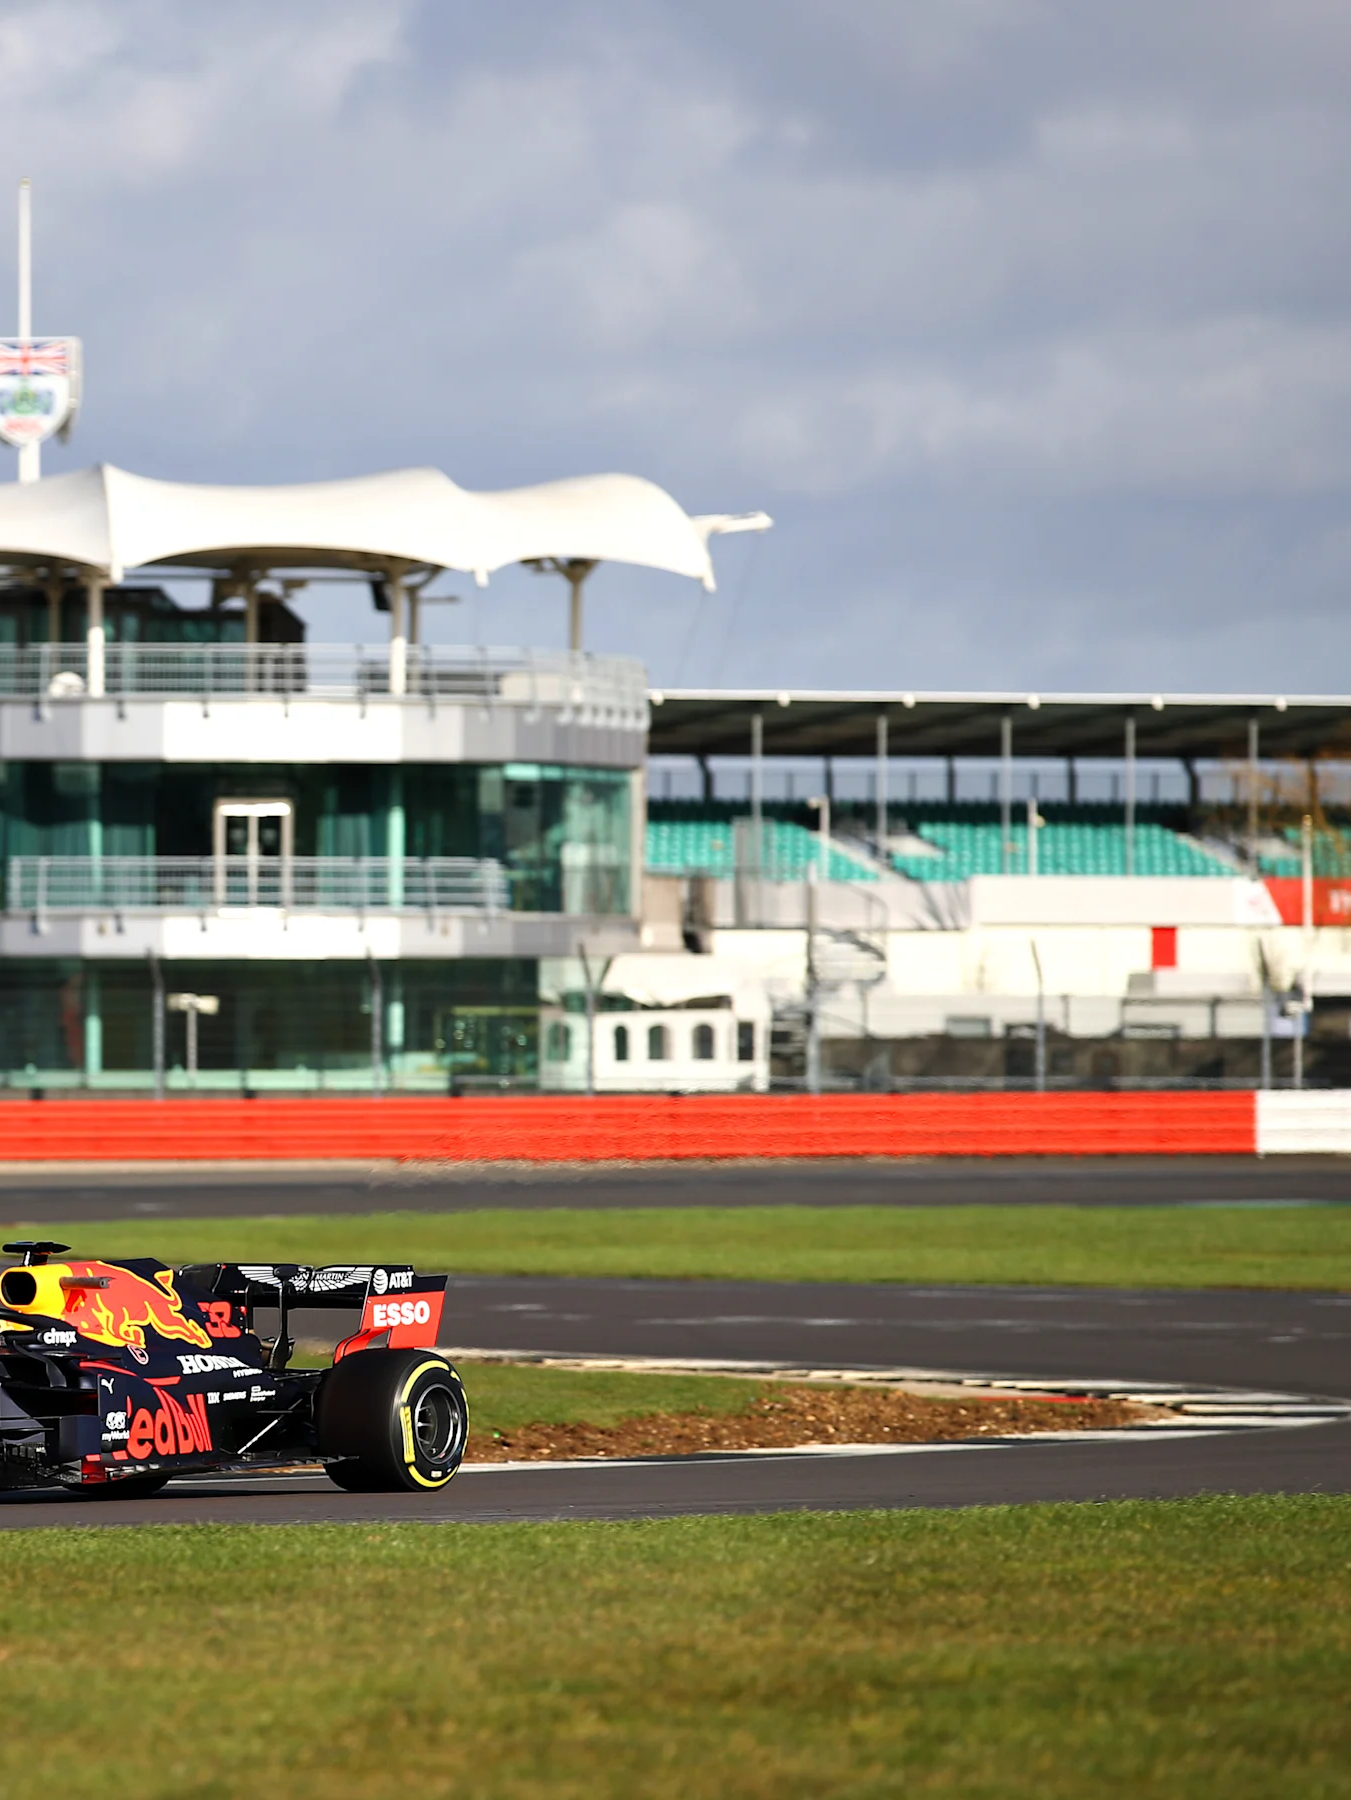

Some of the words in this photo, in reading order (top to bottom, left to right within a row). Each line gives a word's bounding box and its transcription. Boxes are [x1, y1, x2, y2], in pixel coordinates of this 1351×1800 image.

[315, 1272, 344, 1281] MARTIN
[389, 1271, 414, 1289] AT&T
[372, 1300, 430, 1327] ESSO
[176, 1354, 251, 1375] HONDA
